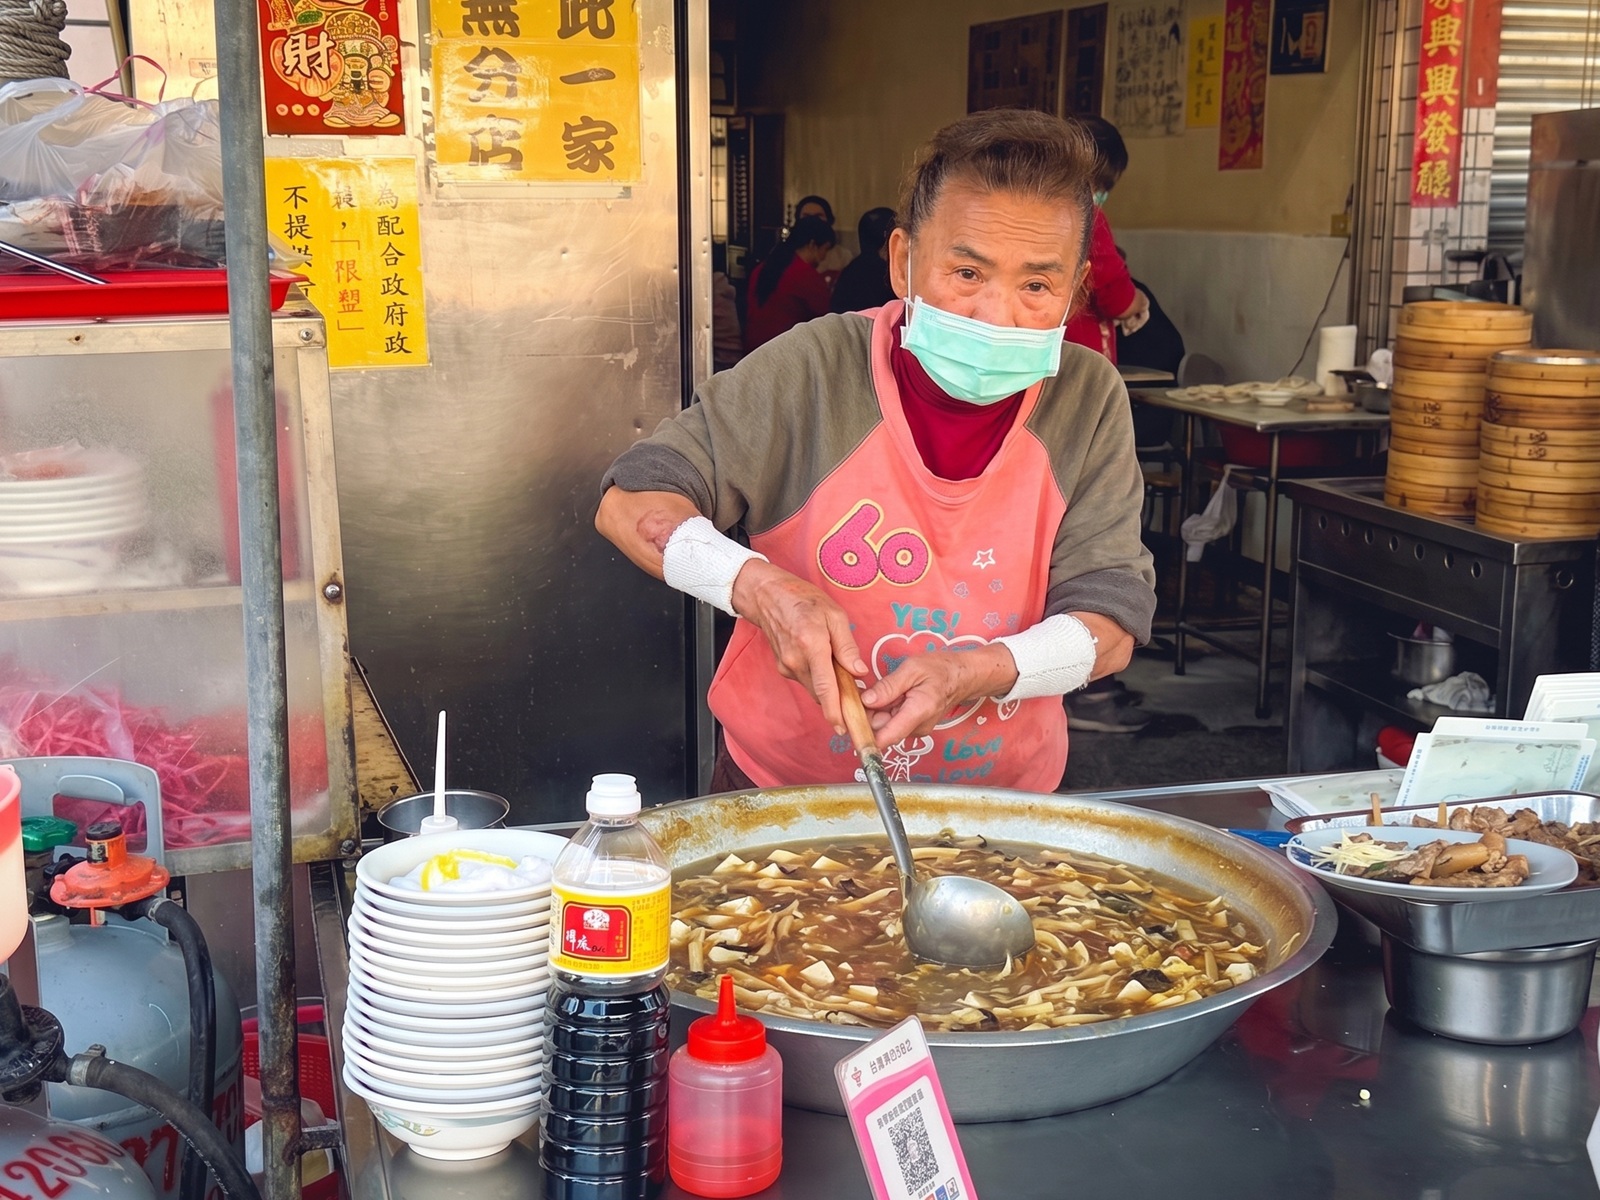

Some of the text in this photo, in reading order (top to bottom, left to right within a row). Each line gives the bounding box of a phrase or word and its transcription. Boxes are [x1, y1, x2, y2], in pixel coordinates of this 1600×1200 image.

[283, 30, 337, 80] 財
[376, 182, 413, 354] 為配合政府政
[817, 498, 932, 591] 60
[891, 602, 961, 637] YES!
